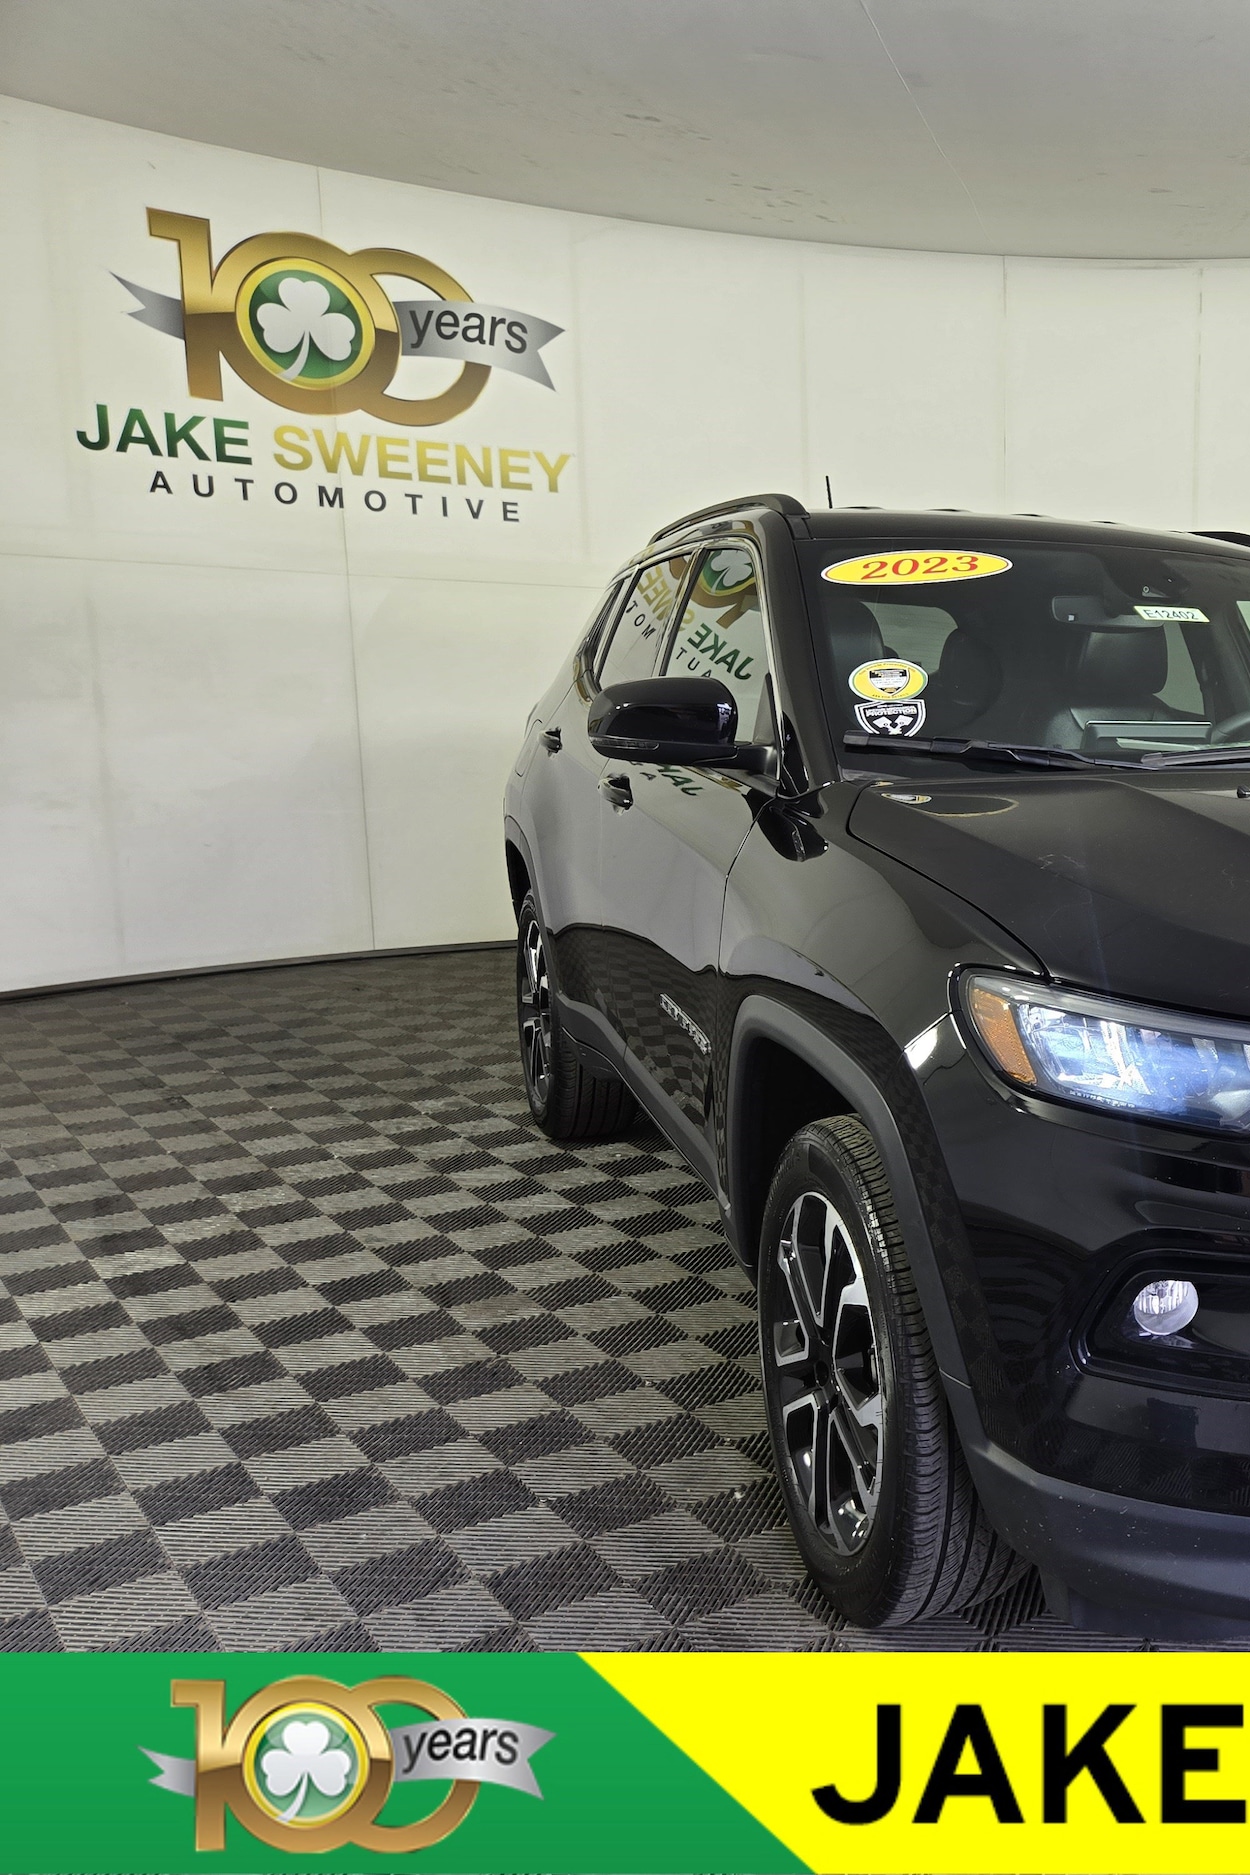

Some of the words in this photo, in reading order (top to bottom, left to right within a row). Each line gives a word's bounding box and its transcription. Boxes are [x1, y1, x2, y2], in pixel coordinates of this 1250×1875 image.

[146, 207, 492, 426] 100
[409, 307, 529, 354] years
[76, 403, 253, 466] JAKE
[273, 425, 571, 493] SWEENEY
[149, 470, 520, 523] AUTOMOTIVE
[861, 555, 979, 581] 2023
[1143, 609, 1199, 620] E12402
